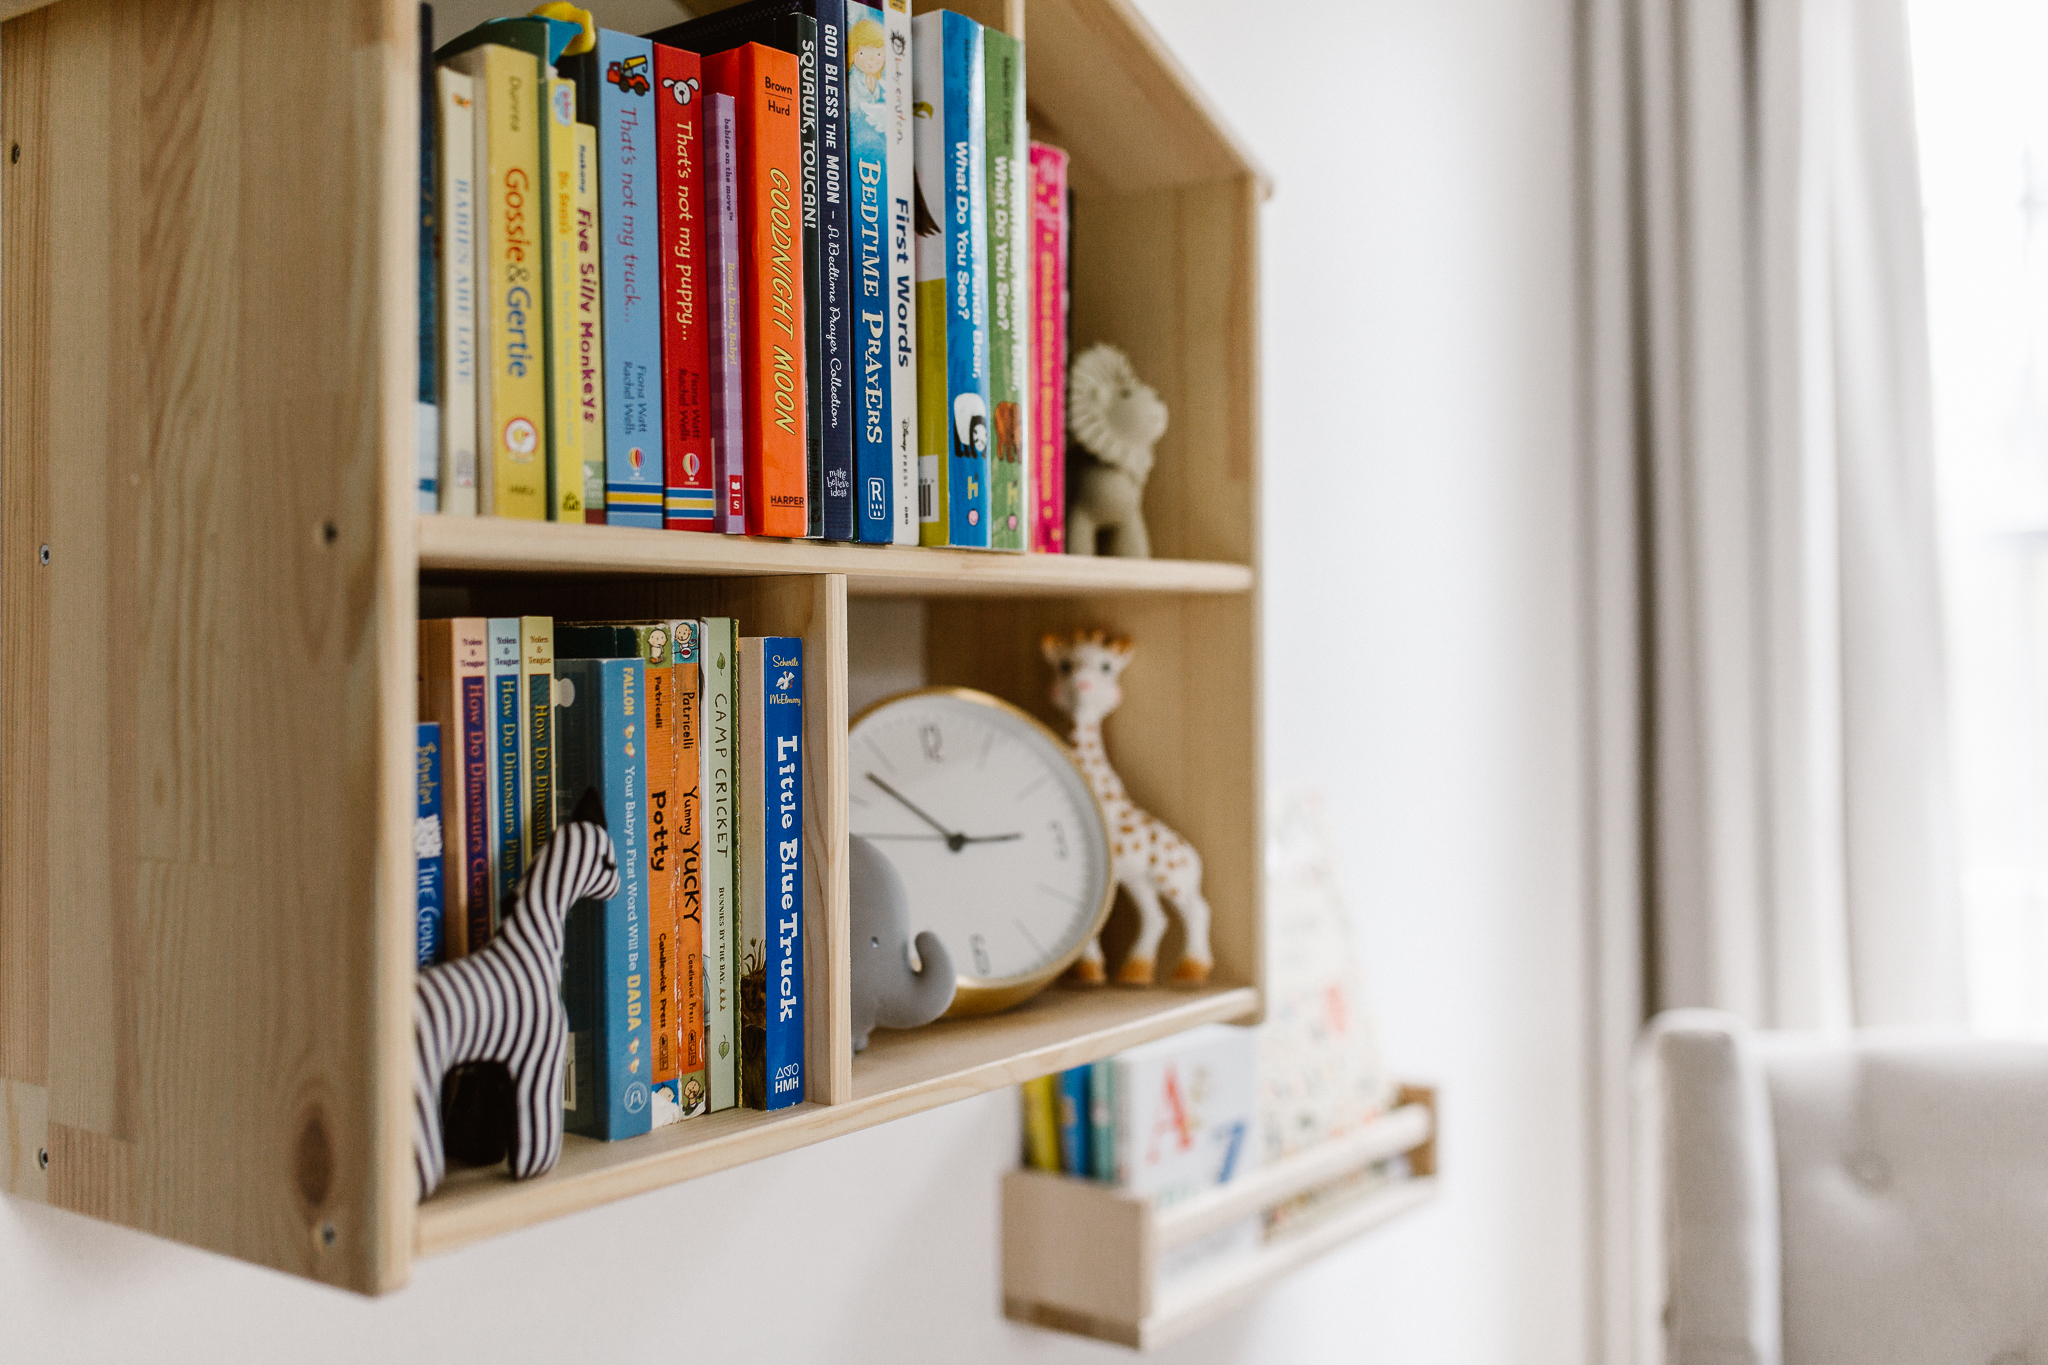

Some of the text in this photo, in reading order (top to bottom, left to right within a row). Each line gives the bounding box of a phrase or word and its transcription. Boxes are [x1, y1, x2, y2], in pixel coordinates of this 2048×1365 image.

[824, 24, 838, 58] GOD
[764, 76, 793, 95] Brown
[767, 100, 791, 117] Hurd
[824, 63, 839, 118] BLESS
[619, 106, 639, 165] That's
[723, 118, 732, 150] babies
[725, 152, 732, 164] on
[800, 39, 817, 230] SQUAWK, TOUCAN!
[826, 123, 837, 149] THE
[621, 172, 638, 208] not
[725, 166, 733, 183] the
[826, 155, 840, 204] MOON
[955, 141, 969, 192] What
[994, 156, 1008, 207] What
[504, 167, 531, 263] Gossie
[616, 215, 637, 248] my
[674, 121, 695, 341] That's not my puppy...
[827, 224, 840, 240] A
[956, 195, 969, 225] Do
[995, 209, 1008, 238] Do
[828, 242, 840, 304] Bedtime
[956, 230, 970, 267] You
[996, 242, 1009, 279] You
[769, 167, 796, 435] GOODNIGHT MOON
[858, 158, 884, 444] BEDTIME PRAYERS
[895, 197, 913, 368] First Words
[957, 270, 970, 321] See?
[971, 264, 984, 325] Panda
[996, 280, 1011, 332] See?
[506, 286, 533, 379] Gertie
[577, 207, 598, 423] Five Silly Monkeys
[727, 262, 739, 367] Read, Read, Baby!
[825, 306, 841, 355] Prayer
[971, 329, 984, 379] Bear,
[623, 361, 638, 436] Rachel Wells
[636, 364, 648, 434] Fiona Watt
[678, 368, 691, 442] Rachel Wells
[690, 372, 702, 440] Fiona Watt
[829, 357, 843, 429] Collection
[826, 477, 849, 489] believe
[829, 467, 847, 481] make
[830, 487, 847, 498] ideas
[770, 494, 805, 507] HARPER
[772, 654, 799, 668] Schertle
[467, 683, 484, 723] How
[501, 680, 516, 717] How
[654, 677, 663, 730] Patricelli
[682, 692, 696, 750] Patricelli
[469, 731, 484, 757] Do
[502, 723, 516, 748] Do
[503, 751, 517, 835] Dinosaurs
[533, 704, 549, 847] How Do Dinosaur
[714, 693, 729, 859] CAMP CRICKET
[470, 762, 486, 853] Dinosaurs
[679, 785, 699, 836] Yummy
[622, 667, 642, 1032] FALLON Your Baby's First Word Will Be DADA
[419, 863, 440, 901] THE
[777, 735, 798, 1023] Little Blue Truck
[718, 887, 726, 927] BUNNIES
[719, 929, 726, 942] BY
[719, 943, 727, 962] THE
[659, 932, 668, 1029] Candlewick Press
[688, 953, 697, 1024] Candlewick Press
[775, 1076, 799, 1094] HMH
